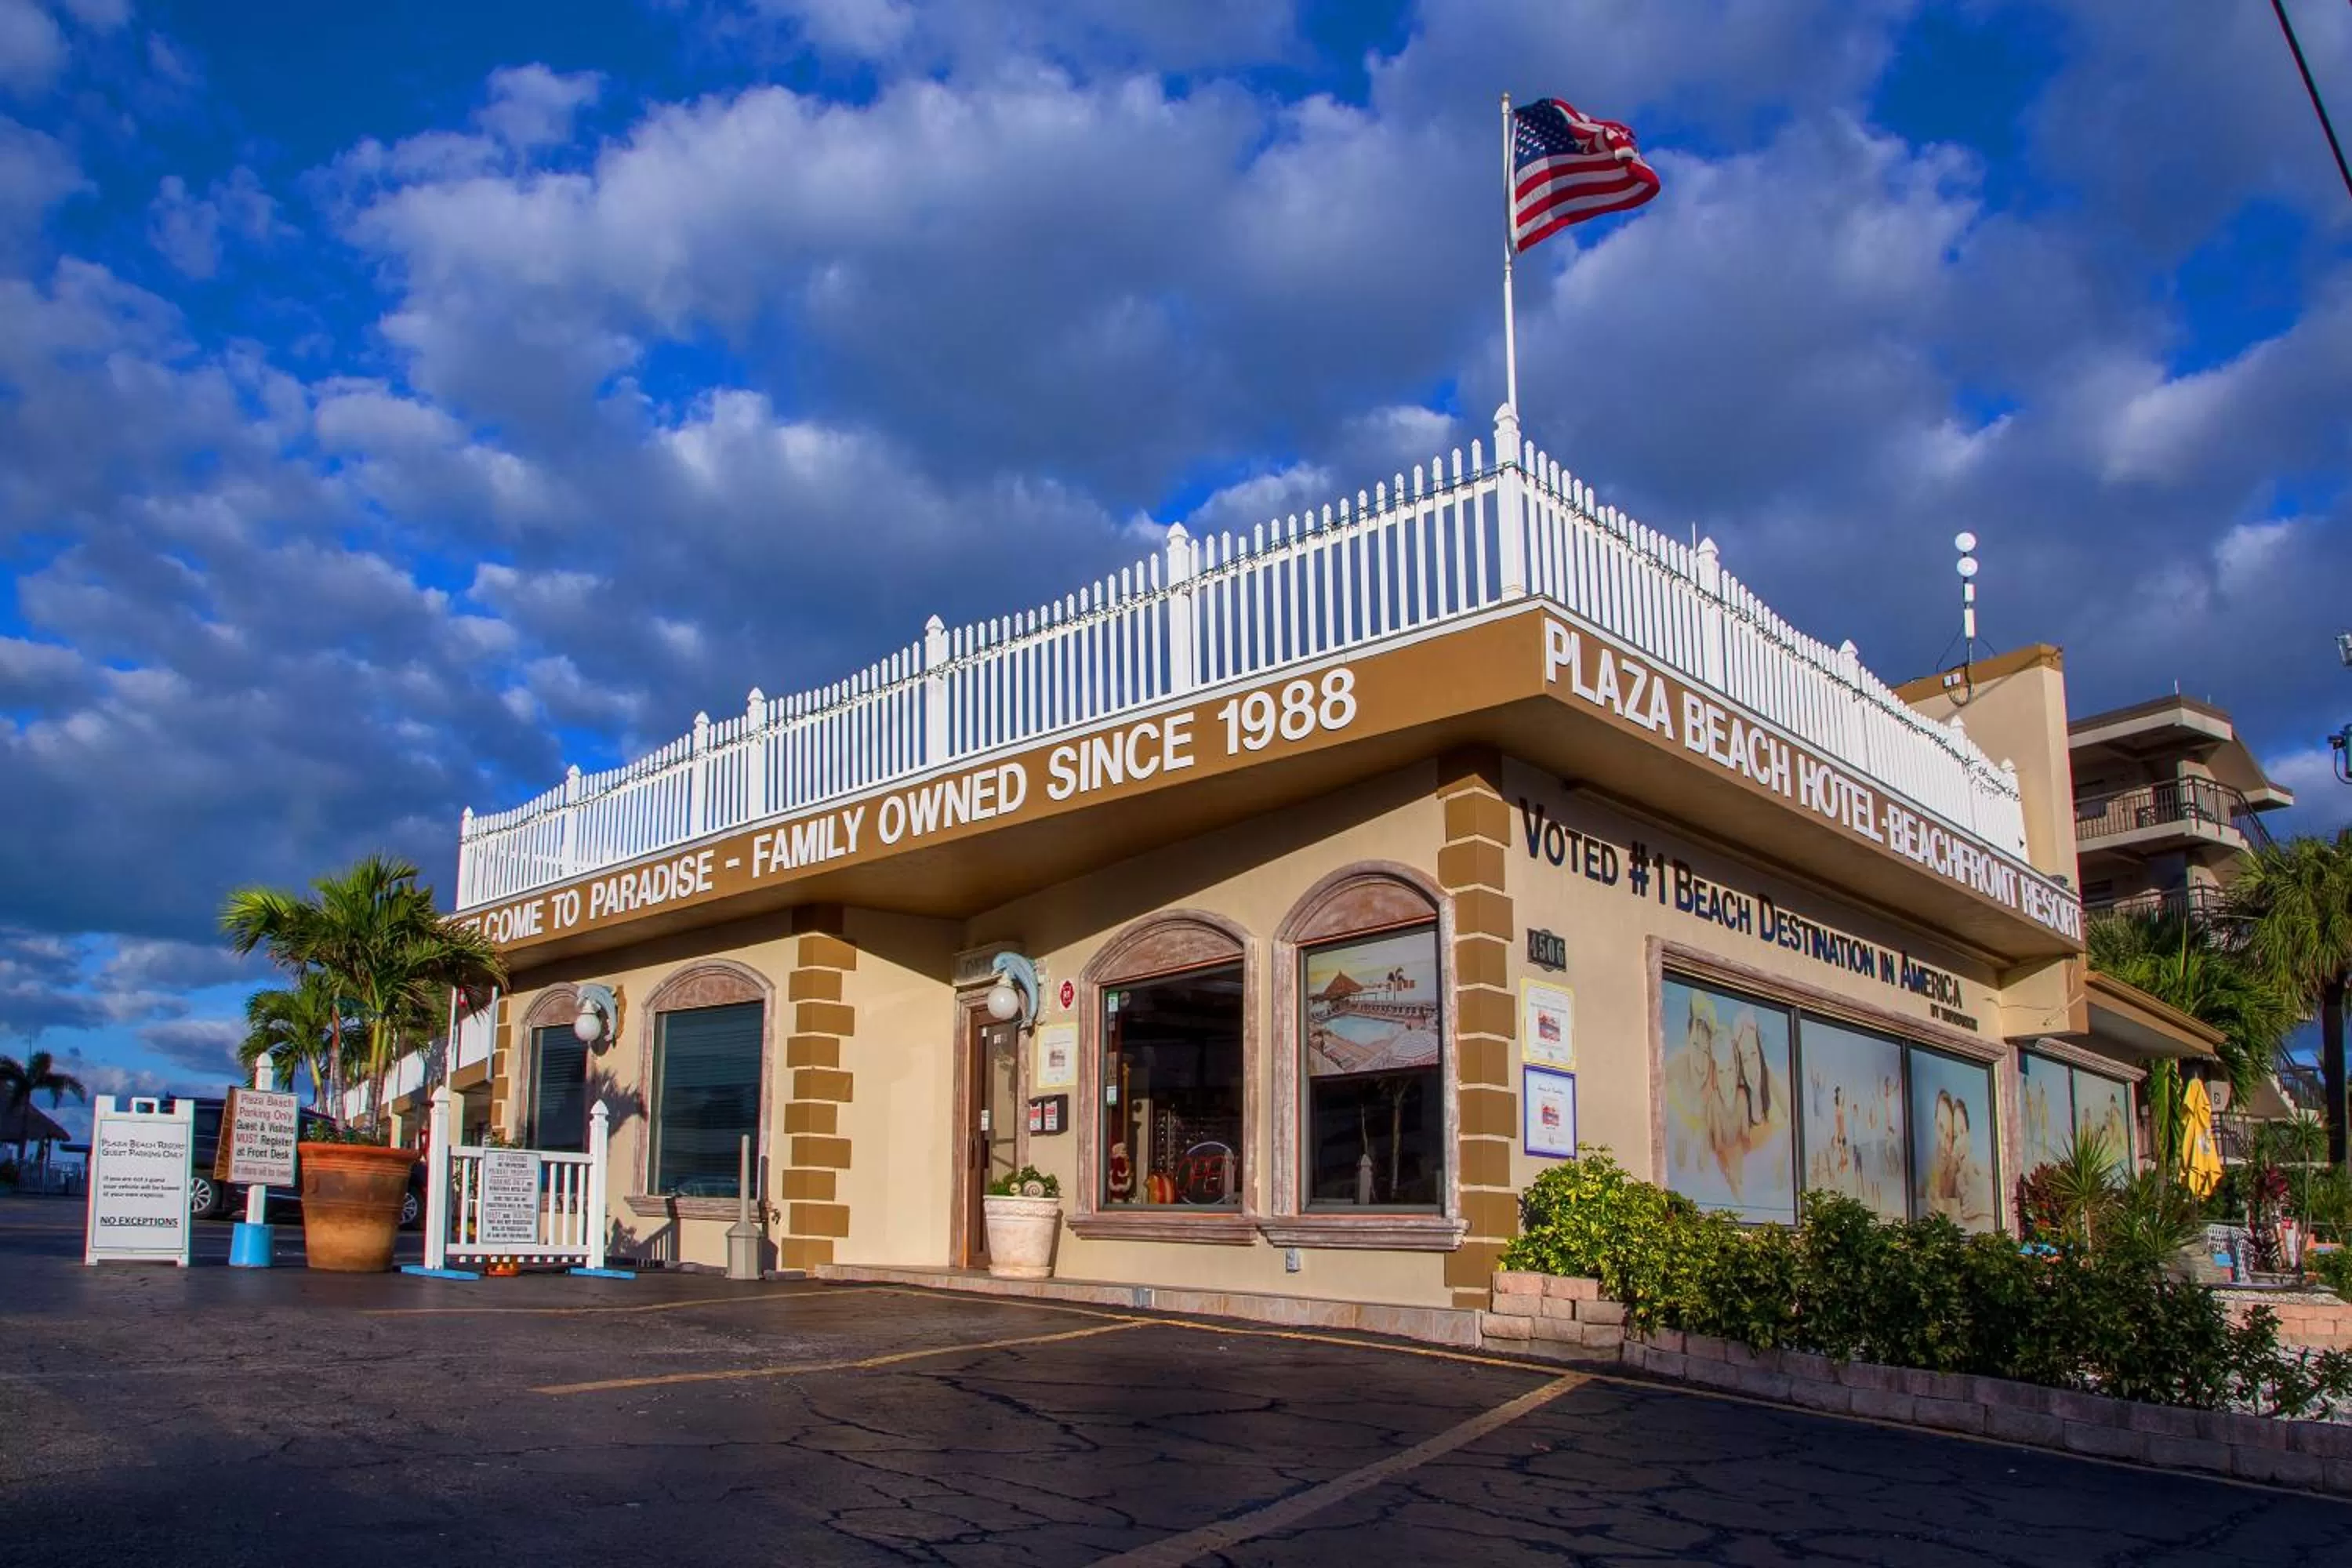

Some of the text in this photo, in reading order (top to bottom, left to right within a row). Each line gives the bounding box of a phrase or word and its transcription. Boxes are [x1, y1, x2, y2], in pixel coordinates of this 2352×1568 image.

[551, 891, 580, 928] TO
[589, 849, 715, 920] PARADISE
[752, 805, 866, 879] FAMILY
[878, 762, 1027, 845] OWNED
[1046, 711, 1195, 801] SINCE
[1216, 668, 1357, 756] 1988
[1544, 617, 1675, 740] PLAZA
[1683, 691, 1792, 798] BEACH
[2020, 874, 2082, 942] RESORT
[1518, 796, 1619, 887] VOTED
[1673, 858, 1752, 935] BEACH
[239, 1107, 271, 1121] Parking
[100, 1216, 179, 1226] NO EXCEPTIONS
